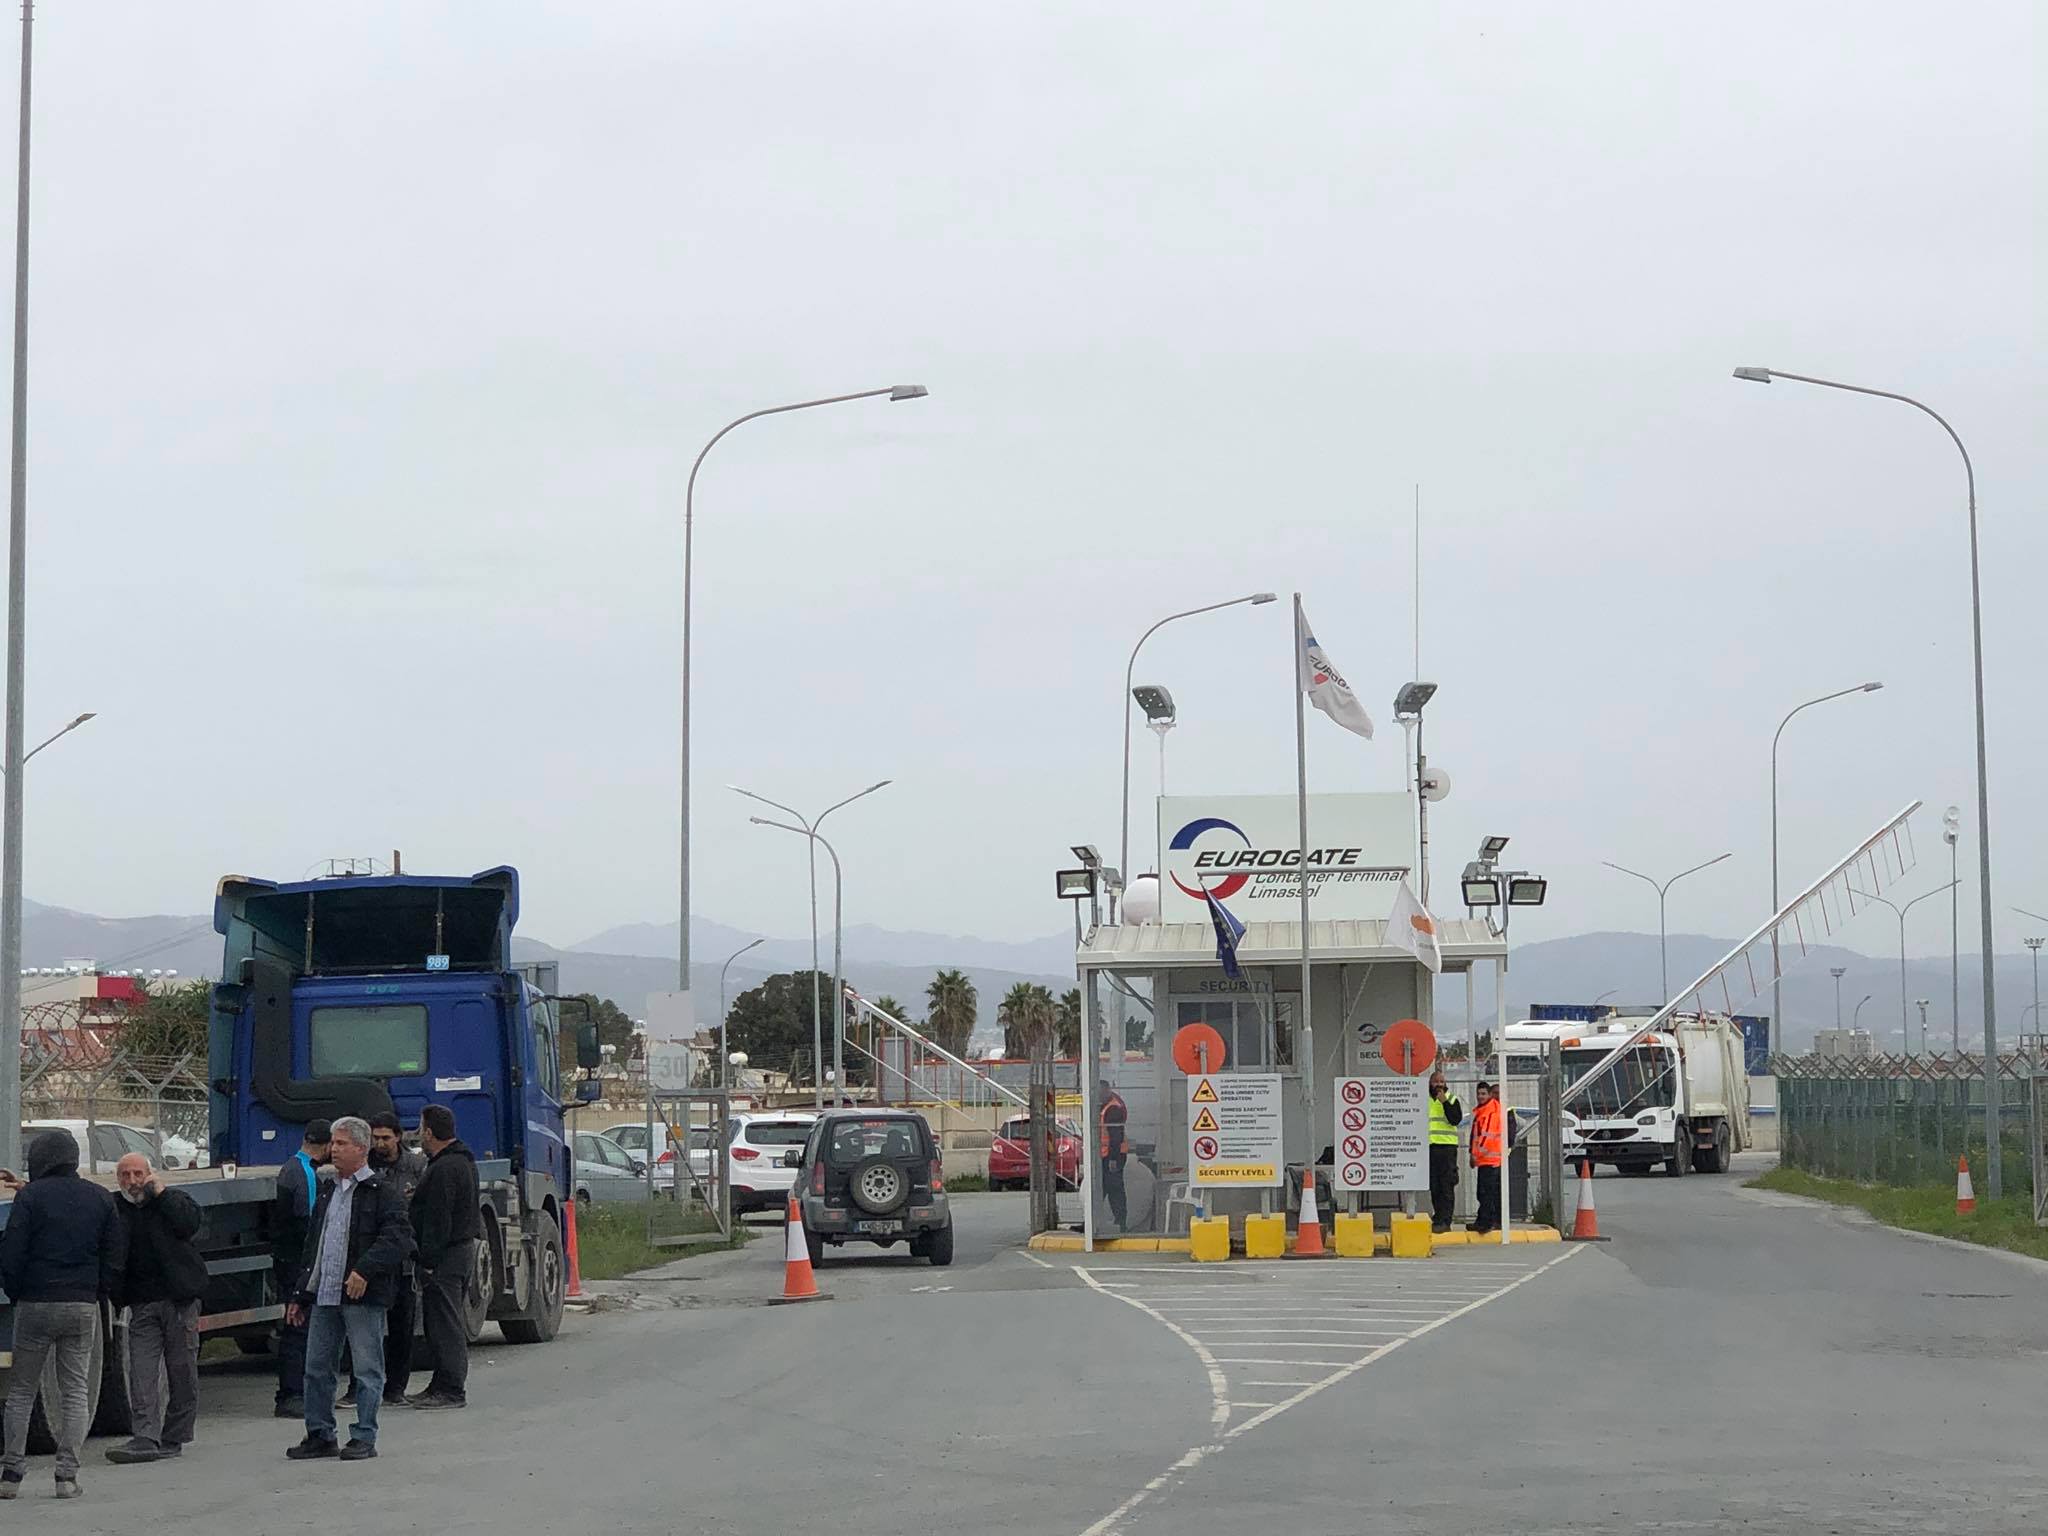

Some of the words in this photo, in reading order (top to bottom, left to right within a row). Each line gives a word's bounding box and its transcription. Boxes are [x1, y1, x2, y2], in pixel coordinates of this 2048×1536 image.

[1309, 655, 1350, 690] EUROG
[1194, 848, 1362, 868] EUROGATE
[1255, 872, 1334, 884] Contaner
[1337, 871, 1406, 882] Terminal
[1248, 885, 1321, 899] Limassol
[427, 957, 448, 968] 989
